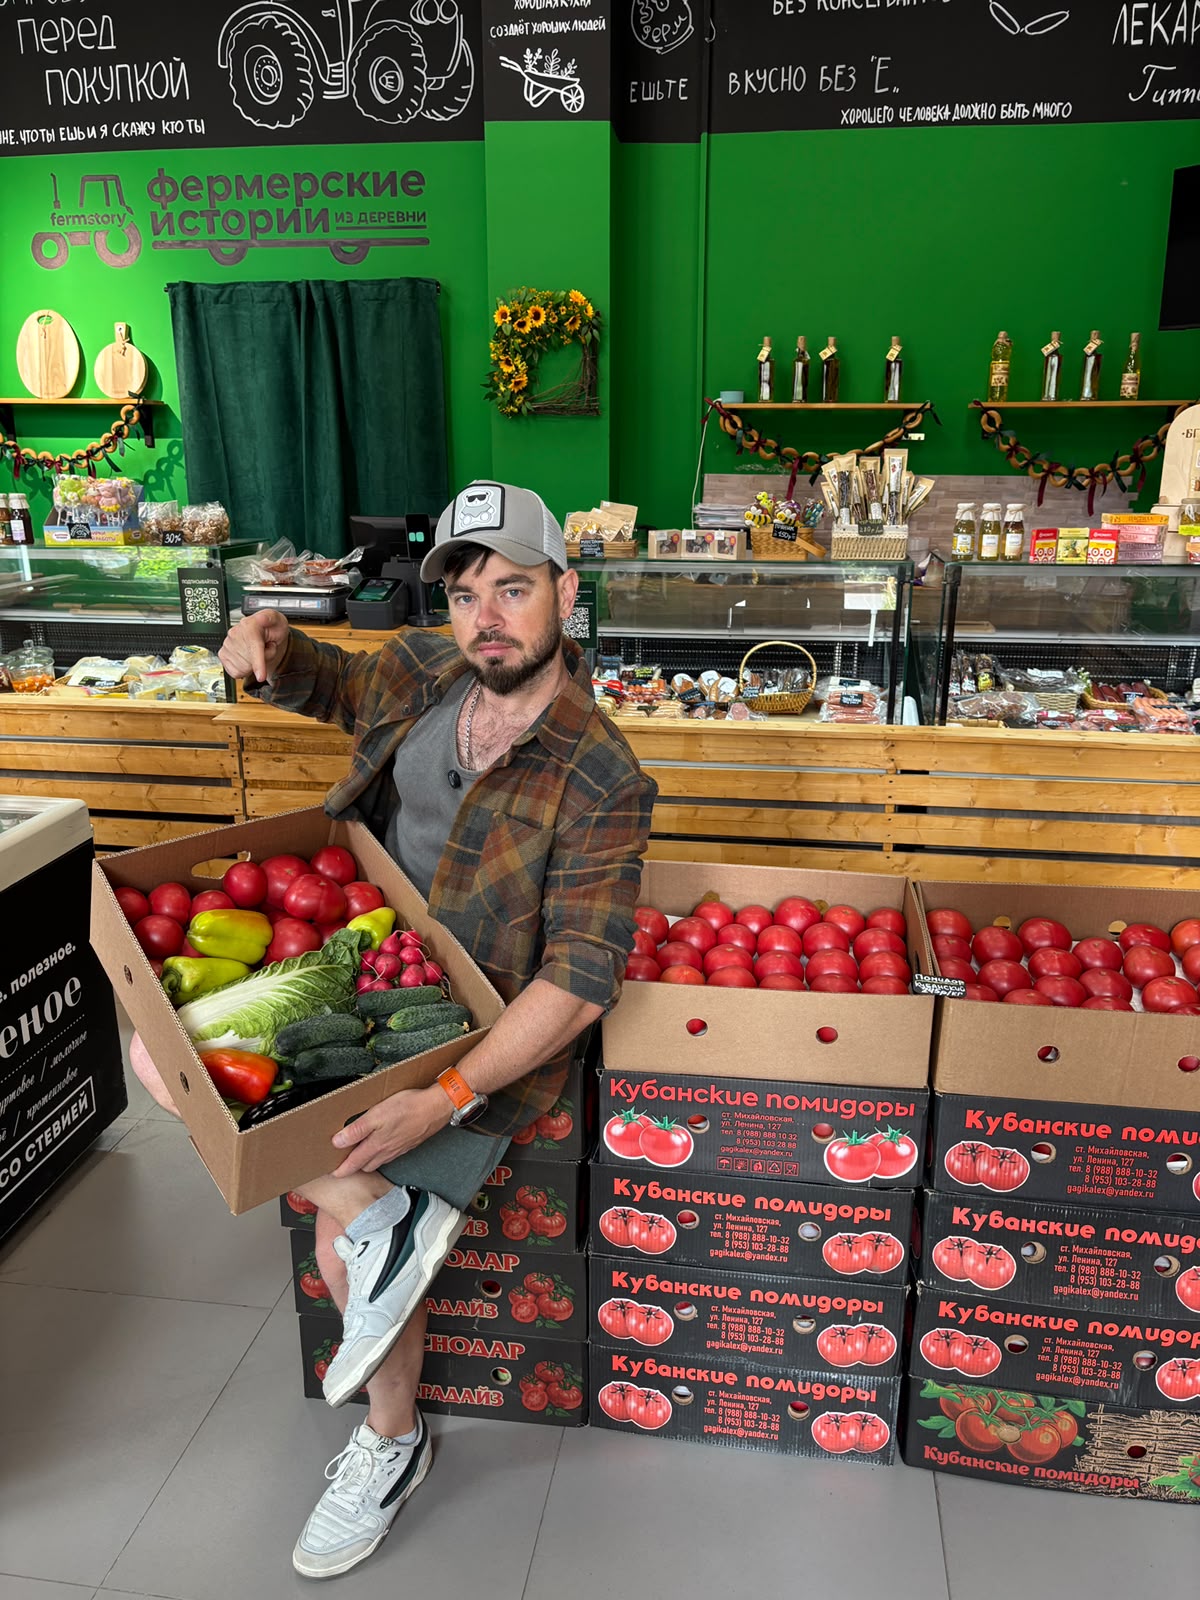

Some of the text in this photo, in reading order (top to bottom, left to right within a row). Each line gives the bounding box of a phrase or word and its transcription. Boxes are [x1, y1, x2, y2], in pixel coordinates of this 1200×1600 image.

[46, 57, 190, 106] ПОКУПКОЙ
[728, 64, 807, 96] ВКУСНО
[819, 64, 856, 92] БЕЗ
[629, 78, 689, 103] ЕШЬТЕ
[841, 101, 1073, 125] ХОРОШЕГО ЧЕЛОВЕКА ДОЛЖНО БЫТЬ МНОГО
[100, 124, 108, 139] Я
[113, 121, 155, 137] СКАЖУ
[162, 120, 184, 134] КТО
[186, 119, 206, 135] ТЫ
[147, 167, 426, 210] фермерские
[50, 211, 127, 228] fermstory
[150, 206, 427, 240] истории ИЗ ДЕРЕВНИ
[10, 942, 76, 995] полезное.
[609, 1078, 916, 1121] Кубанские помидоры
[25, 1091, 89, 1162] СТЕВИЕЙ
[964, 1108, 1112, 1139] Кубанские
[1087, 1145, 1149, 1159] Михайловская,
[1073, 1155, 1135, 1167] ул. Ленина, 127
[1069, 1165, 1158, 1179] тел. 8 (988) 888-10-32
[1084, 1174, 1156, 1189] 8 (953) 103-28-88
[1067, 1184, 1154, 1199] gagikalex@yandex.ru
[613, 1177, 891, 1224] Кубанские помидоры
[713, 1222, 768, 1233] ул. Ленина, 127
[725, 1213, 781, 1227] Михайловская,
[951, 1206, 1096, 1239] Кубанские
[725, 1231, 730, 1239] 8
[731, 1231, 750, 1241] (988)
[752, 1233, 790, 1245] 888-10-32
[725, 1240, 789, 1253] 8 (953) 103-28-88
[1060, 1244, 1133, 1260] ст. Михайловская,
[709, 1249, 788, 1262] gagikalex@yandex.ru
[1058, 1254, 1118, 1267] ул. Ленина, 127
[1054, 1264, 1142, 1280] тел. 8 (988) 888-10-32
[1070, 1274, 1140, 1291] 8 (953) 103-28-88
[611, 1270, 884, 1316] Кубанские помидоры
[1053, 1285, 1139, 1301] gagikalex@yandex.ru
[722, 1305, 776, 1319] Михайловская,
[722, 1314, 750, 1325] Ленина,
[752, 1317, 763, 1325] 127
[937, 1300, 1079, 1333] Кубанские
[721, 1331, 784, 1345] 8 (953) 103-28-88
[728, 1323, 746, 1333] (988)
[748, 1325, 785, 1337] 888-10-32
[706, 1340, 783, 1355] gagikalex@yandex.ru
[1041, 1345, 1100, 1358] ул. Ленина, 127
[1055, 1336, 1115, 1352] Михайловская,
[1037, 1354, 1123, 1371] тел. 8 (988) 888-10-32
[611, 1354, 877, 1404] Кубанские помидоры
[1052, 1363, 1121, 1380] 8 (953) 103-28-88
[1036, 1372, 1119, 1390] gagikalex@yandex.ru
[707, 1399, 759, 1411] ул. Ленина, 127
[719, 1390, 772, 1404] Михайловская,
[718, 1416, 780, 1431] 8 (953) 103-28-88
[725, 1408, 742, 1418] (988)
[744, 1411, 780, 1423] 888-10-32
[703, 1425, 779, 1440] gagikalex@yandex.ru
[924, 1445, 1140, 1489] Кубанские помидоры
